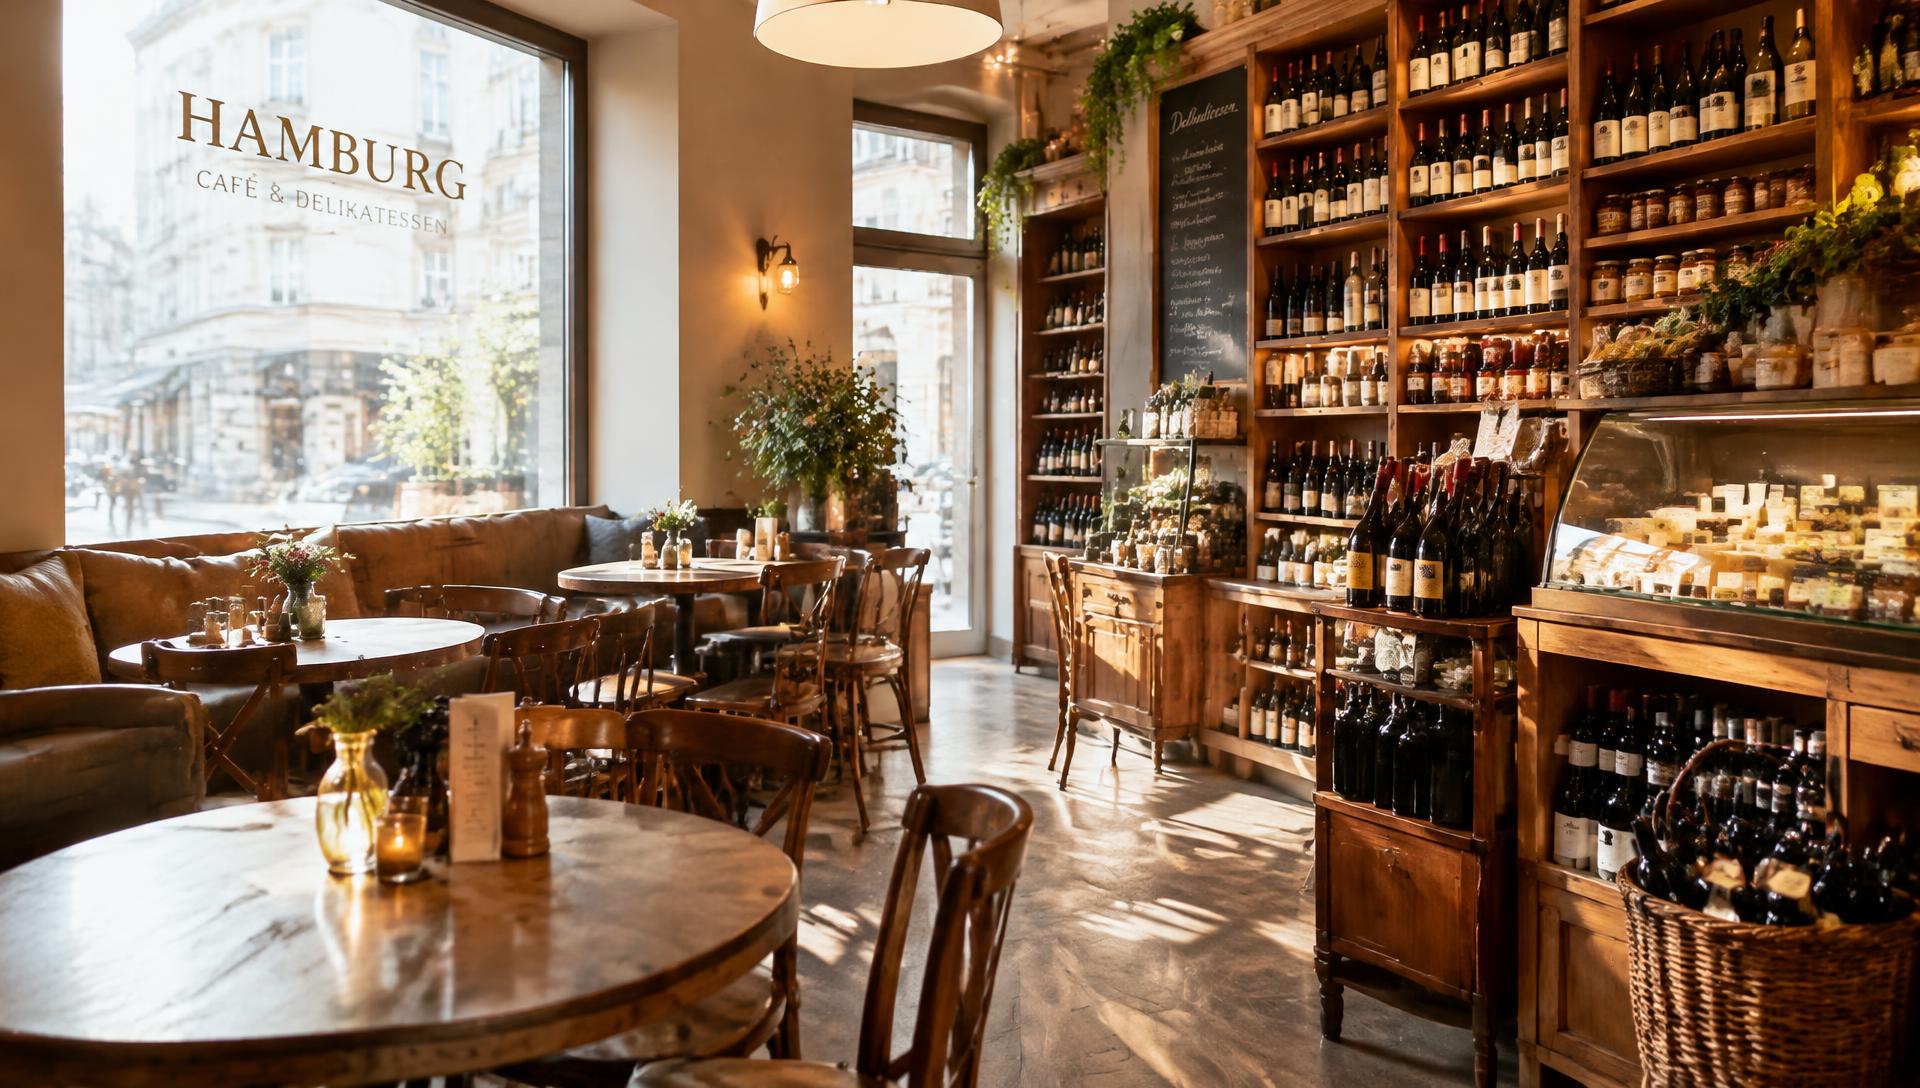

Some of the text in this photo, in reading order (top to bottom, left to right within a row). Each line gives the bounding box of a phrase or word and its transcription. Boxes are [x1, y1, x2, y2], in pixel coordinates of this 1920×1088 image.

[177, 90, 467, 201] HAMBURG
[270, 181, 284, 204] &
[296, 189, 448, 235] DELIKATESSEN
